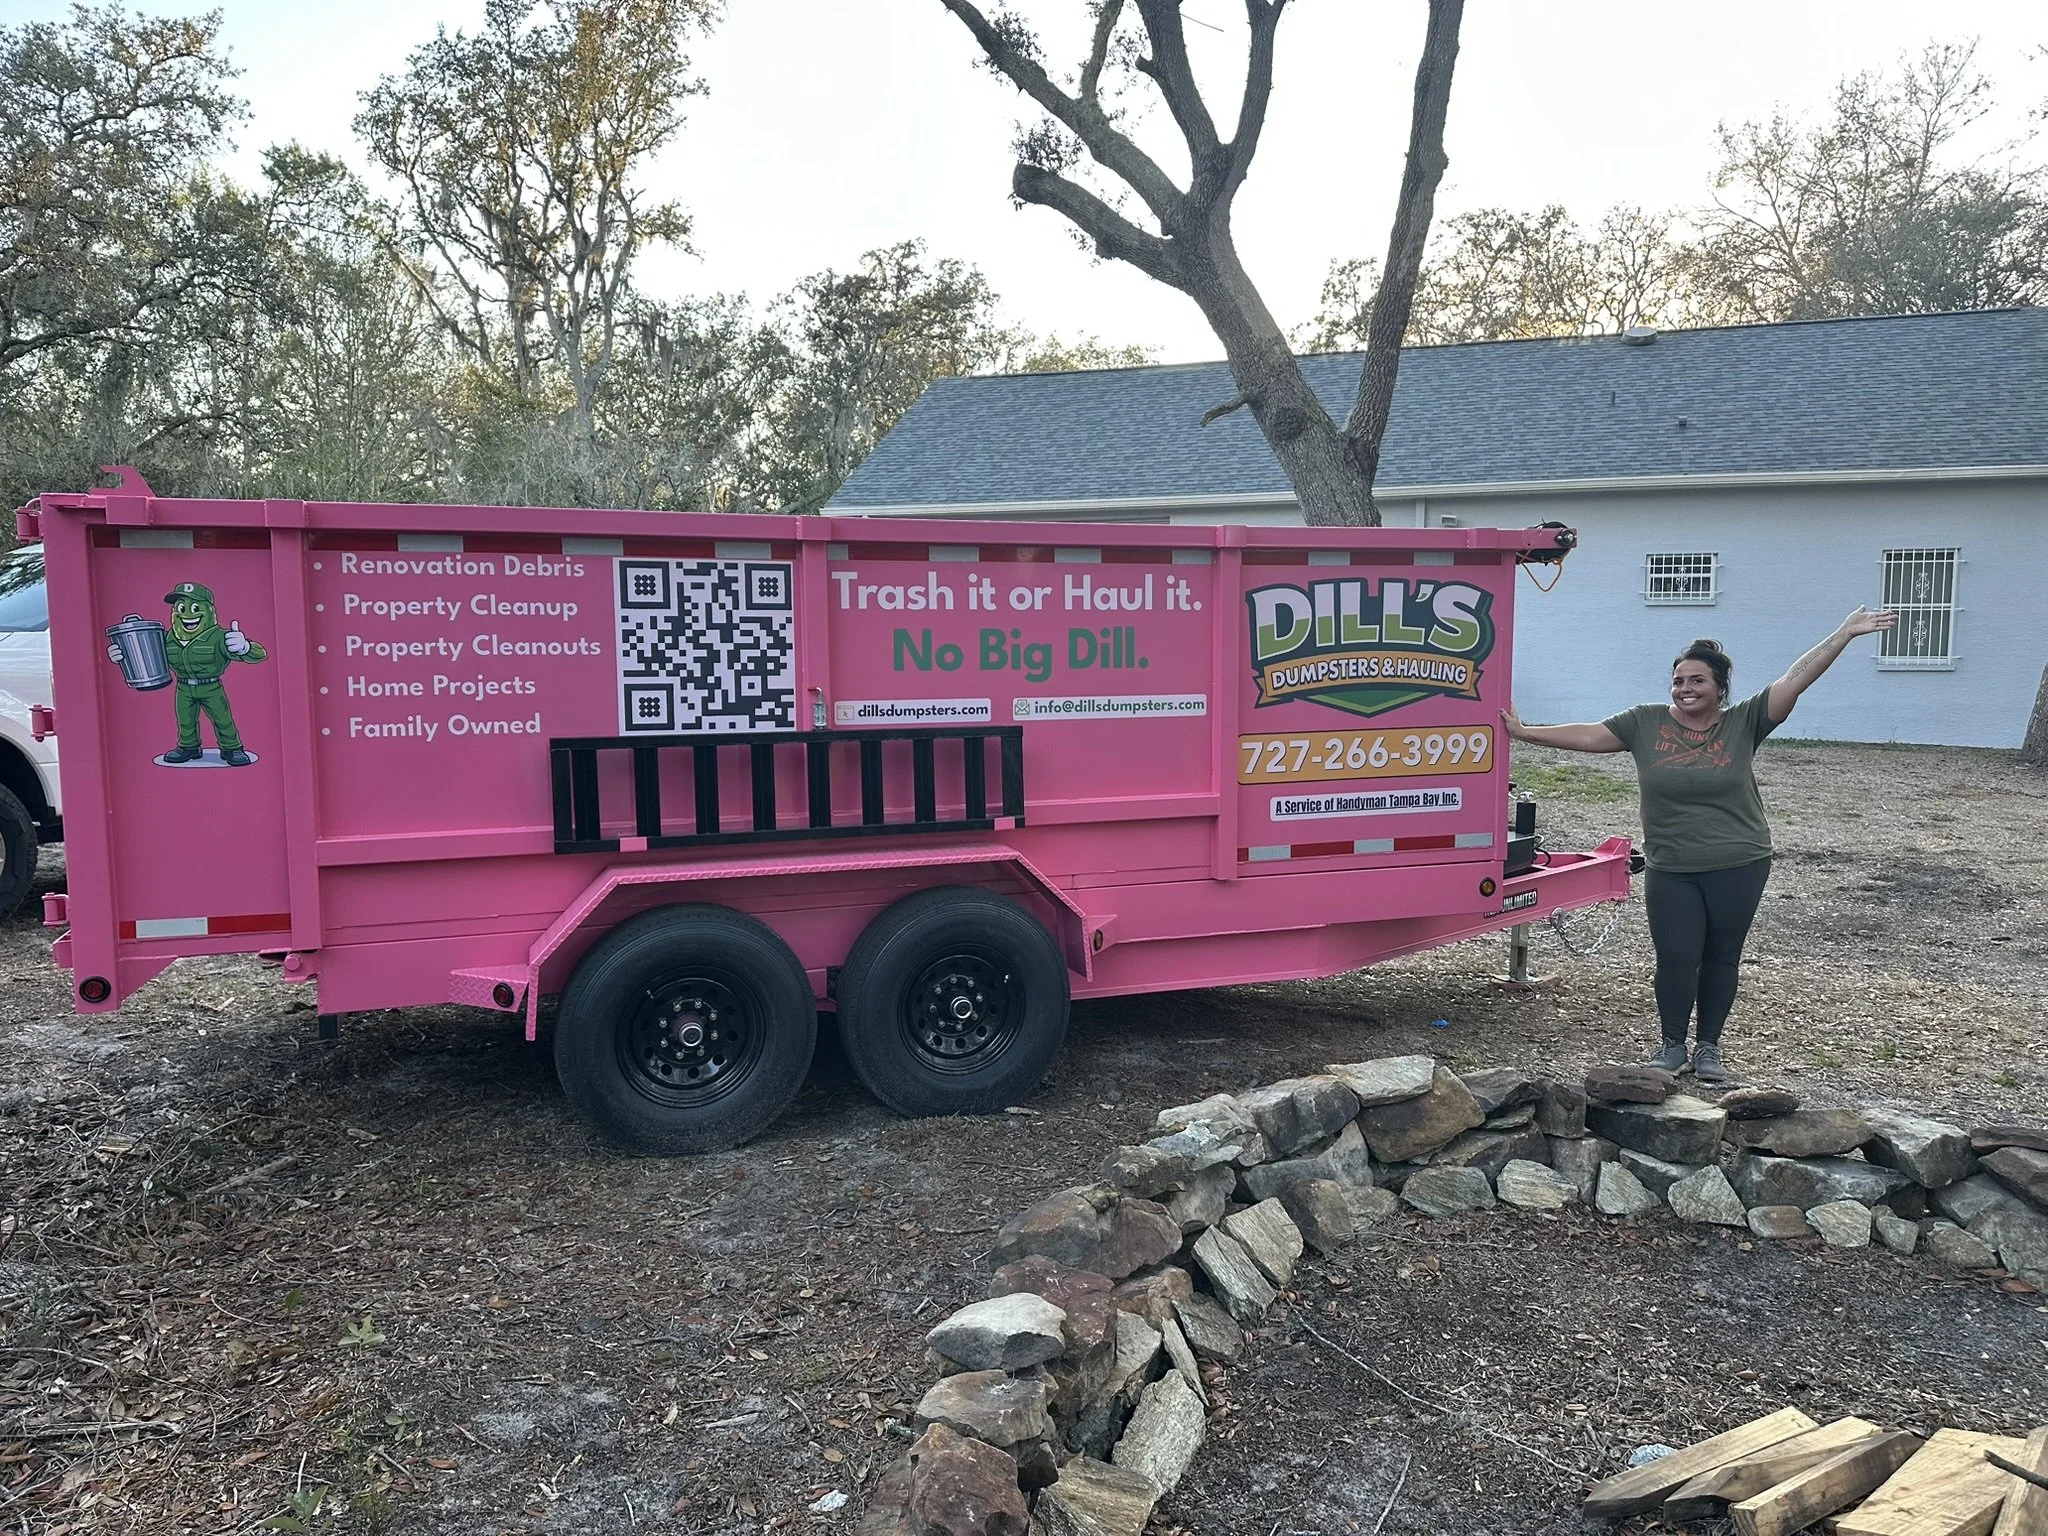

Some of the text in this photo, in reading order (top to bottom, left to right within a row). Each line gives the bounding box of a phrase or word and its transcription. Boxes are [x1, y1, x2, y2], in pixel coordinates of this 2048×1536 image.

[341, 552, 585, 577] Renovation Debris
[184, 584, 193, 592] D
[831, 571, 1202, 611] Trash it or Haul it.
[343, 593, 578, 621] Property Cleanup
[1252, 582, 1481, 660] DILL'S
[345, 634, 601, 662] Property Cleanouts
[893, 626, 1149, 683] No Big Dill.
[1271, 657, 1467, 689] DUMPSTERS & HAULING
[347, 674, 536, 701] Home Projects
[857, 702, 989, 720] dillsdumpsters.com
[1034, 697, 1205, 716] info@dillsdumpsters.com
[349, 712, 541, 742] Family Owned
[1241, 732, 1488, 774] 727-266-3999
[1655, 740, 1678, 753] LIFT
[1275, 791, 1459, 814] A Service of Handyman Tampa Bay Inc.
